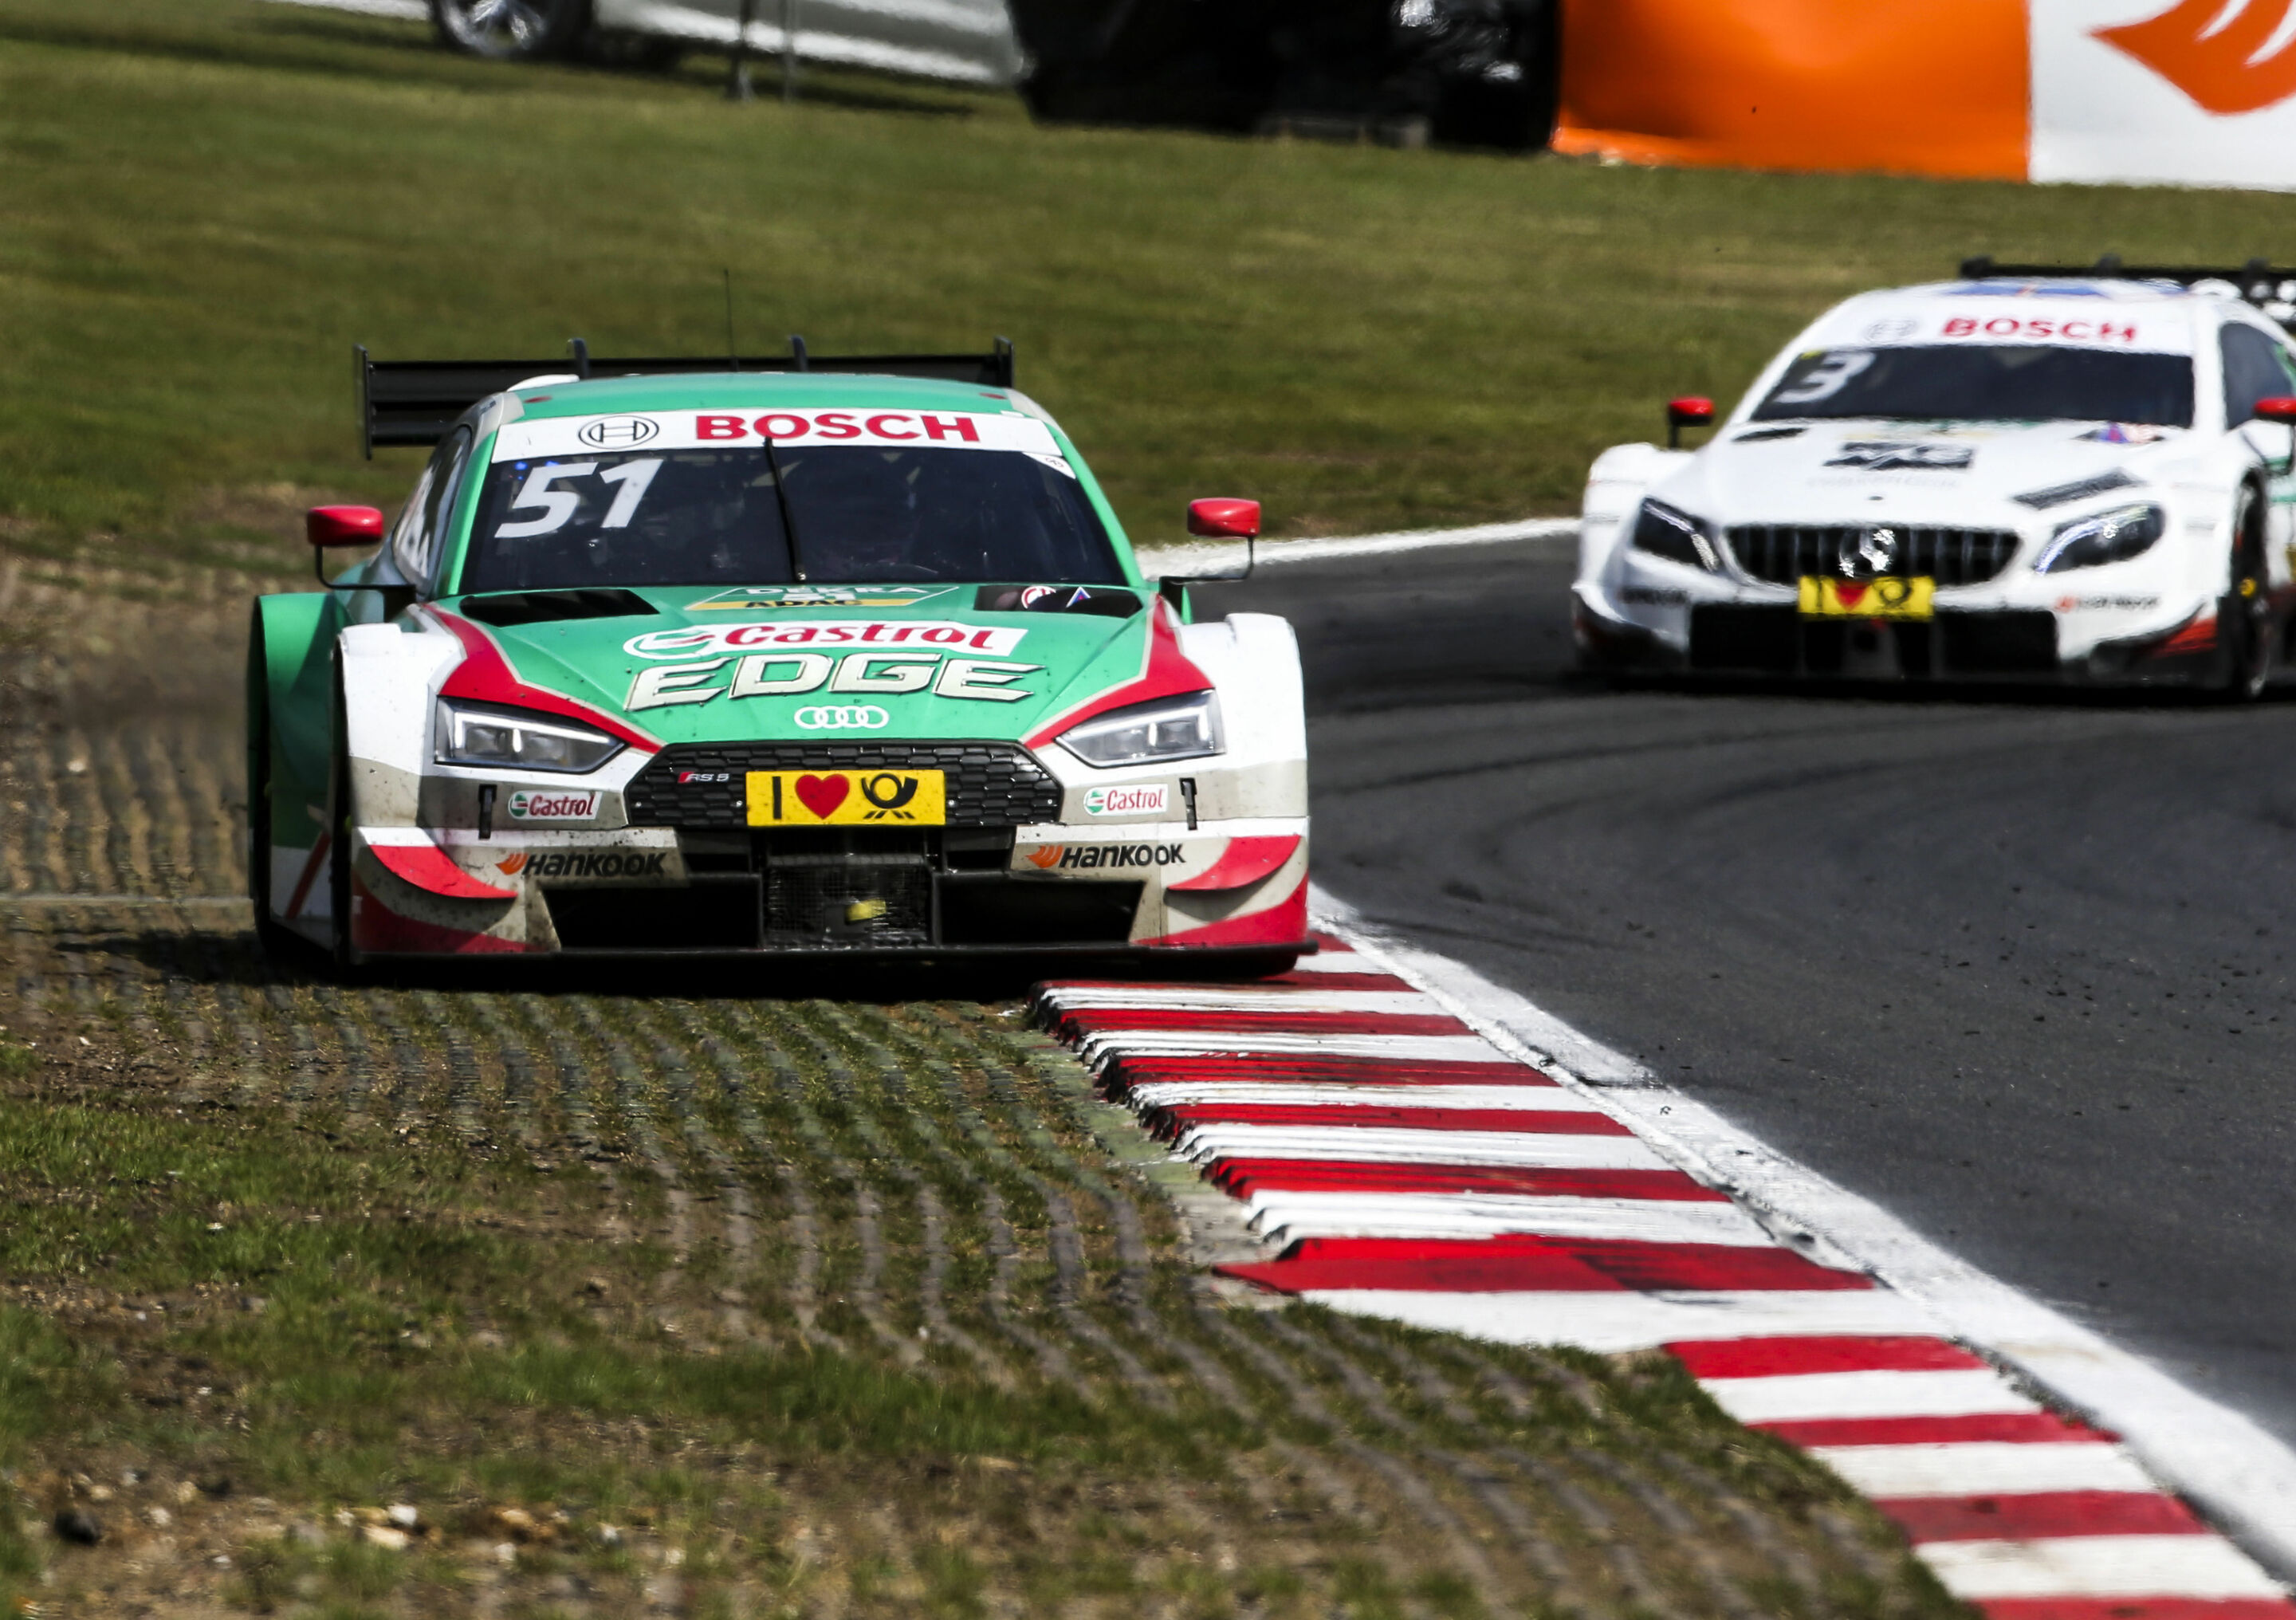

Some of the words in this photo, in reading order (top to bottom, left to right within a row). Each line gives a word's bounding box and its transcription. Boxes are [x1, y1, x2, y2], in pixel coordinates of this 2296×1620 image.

[1941, 317, 2138, 342] BOSCH
[1773, 350, 1877, 404] 3
[696, 414, 981, 442] BOSCH
[494, 459, 663, 538] 51
[725, 623, 994, 649] Castrol
[623, 652, 1046, 711] EDGE
[685, 773, 714, 782] RS
[716, 773, 729, 782] 5
[529, 792, 596, 816] Castrol
[772, 777, 782, 820] I
[1107, 789, 1164, 811] Castrol
